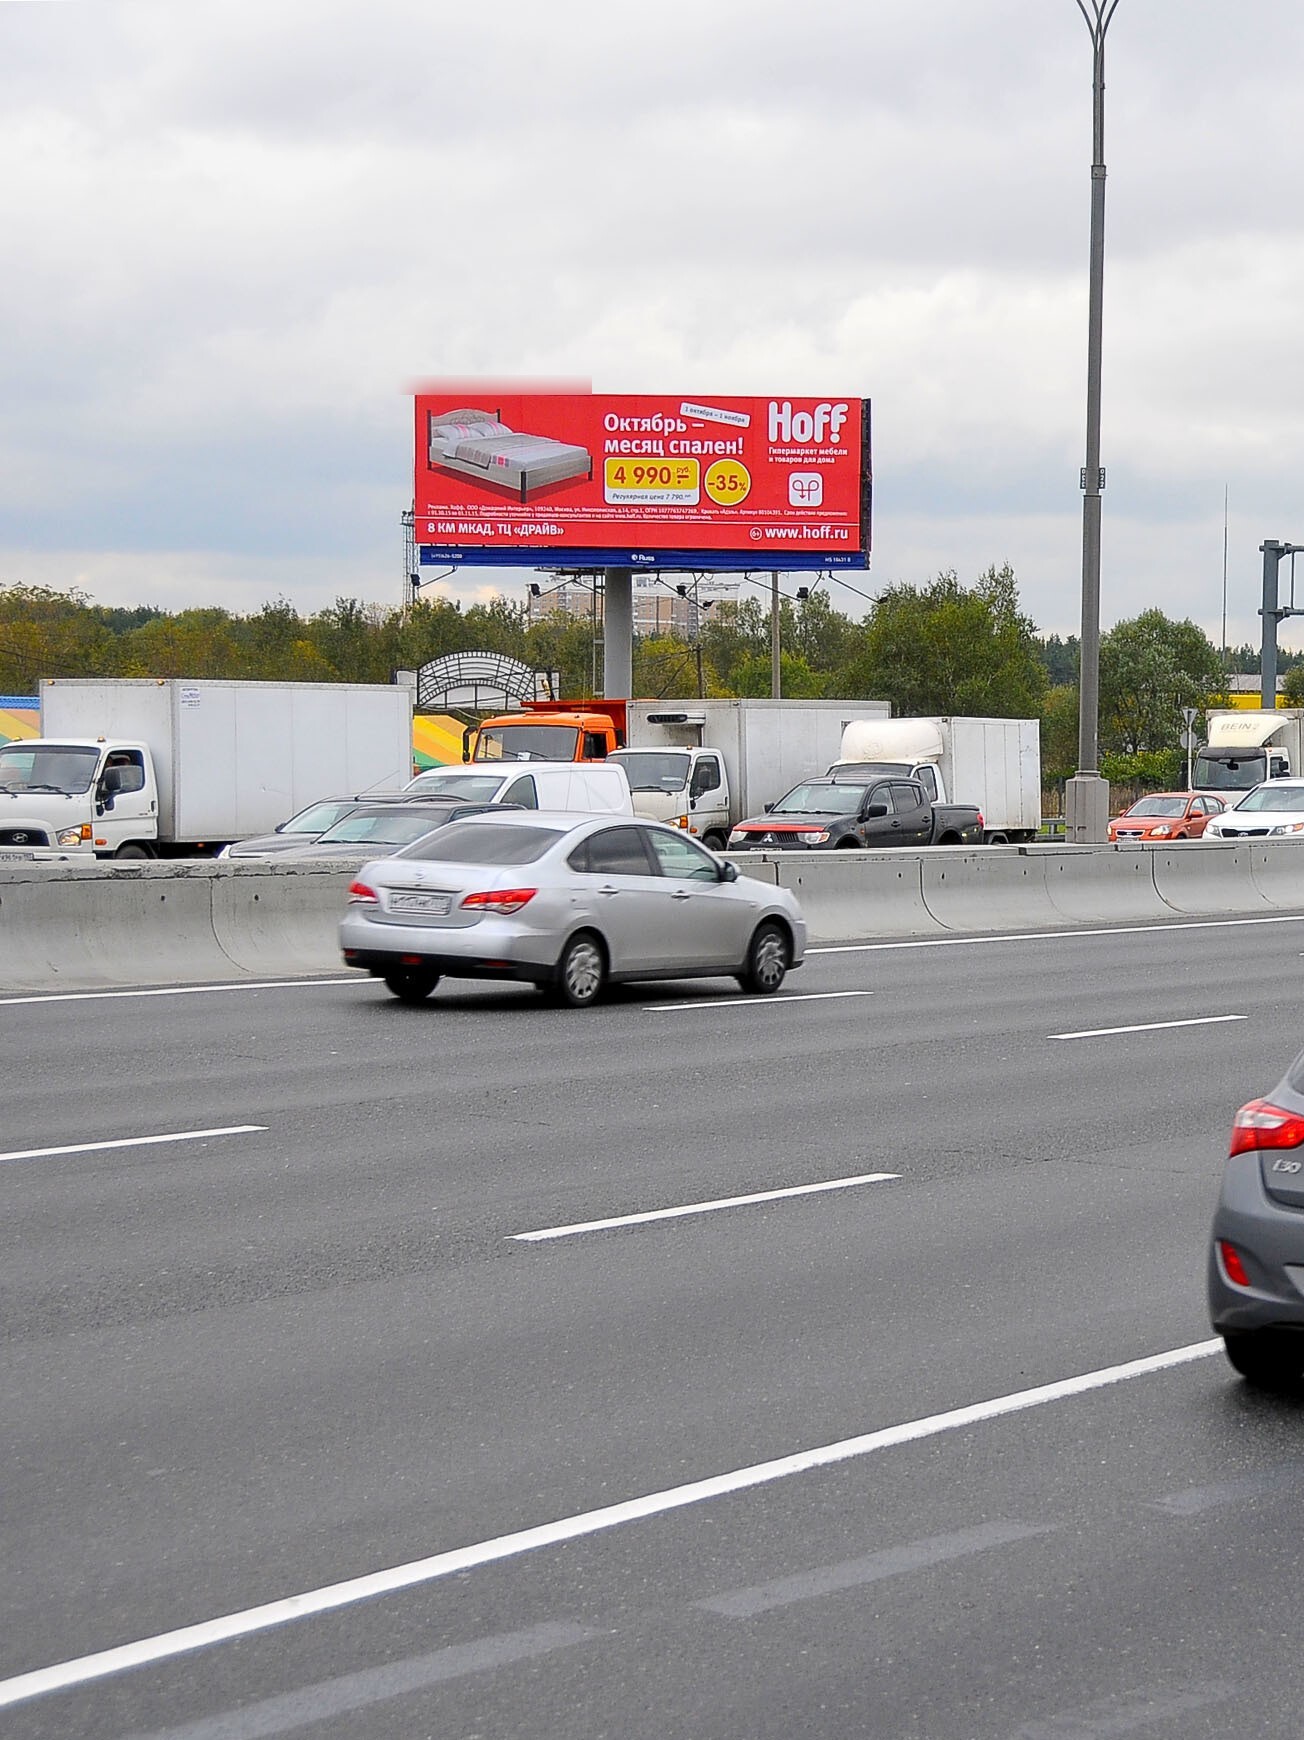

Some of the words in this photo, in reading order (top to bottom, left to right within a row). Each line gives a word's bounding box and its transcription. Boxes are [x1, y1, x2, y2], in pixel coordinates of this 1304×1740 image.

[604, 413, 687, 437] Октябрь
[768, 401, 849, 443] Hoff
[604, 439, 664, 456] месяц
[669, 437, 744, 455] спален!
[768, 447, 818, 456] Гипермаркет
[818, 447, 848, 456] мебели
[613, 466, 627, 484] 4
[633, 466, 672, 485] 990
[612, 493, 648, 501] Регулярная
[427, 523, 435, 533] 8
[437, 523, 456, 533] КМ
[458, 524, 495, 535] МКАД,
[497, 524, 511, 535] ТЦ
[513, 523, 564, 535] «ДРАЙВ»
[765, 526, 848, 539] www.hoff.ru
[1272, 1159, 1302, 1173] i30
